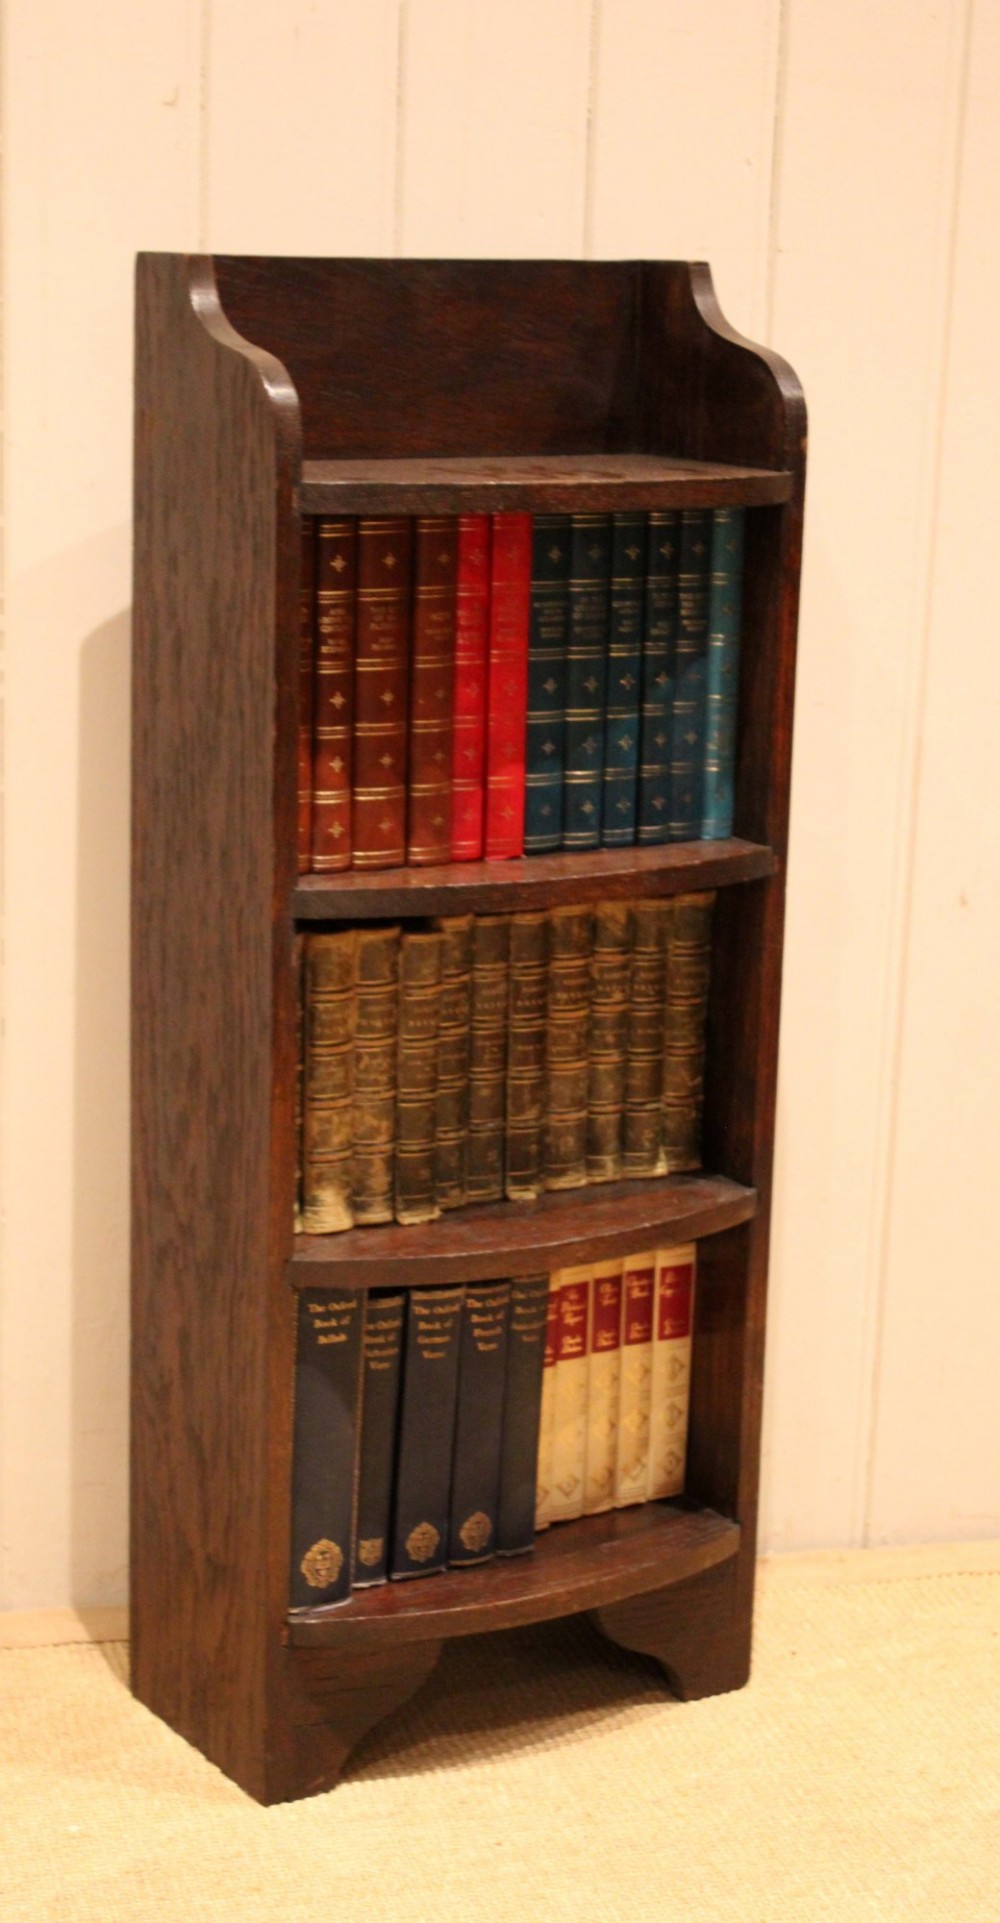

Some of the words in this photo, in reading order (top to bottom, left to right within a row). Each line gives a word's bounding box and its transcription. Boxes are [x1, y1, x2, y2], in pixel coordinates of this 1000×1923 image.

[307, 1303, 326, 1313] The
[327, 1299, 358, 1311] Oxford
[412, 1305, 430, 1315] The
[313, 1319, 338, 1329] Book
[339, 1315, 352, 1326] of
[418, 1321, 442, 1330] Book
